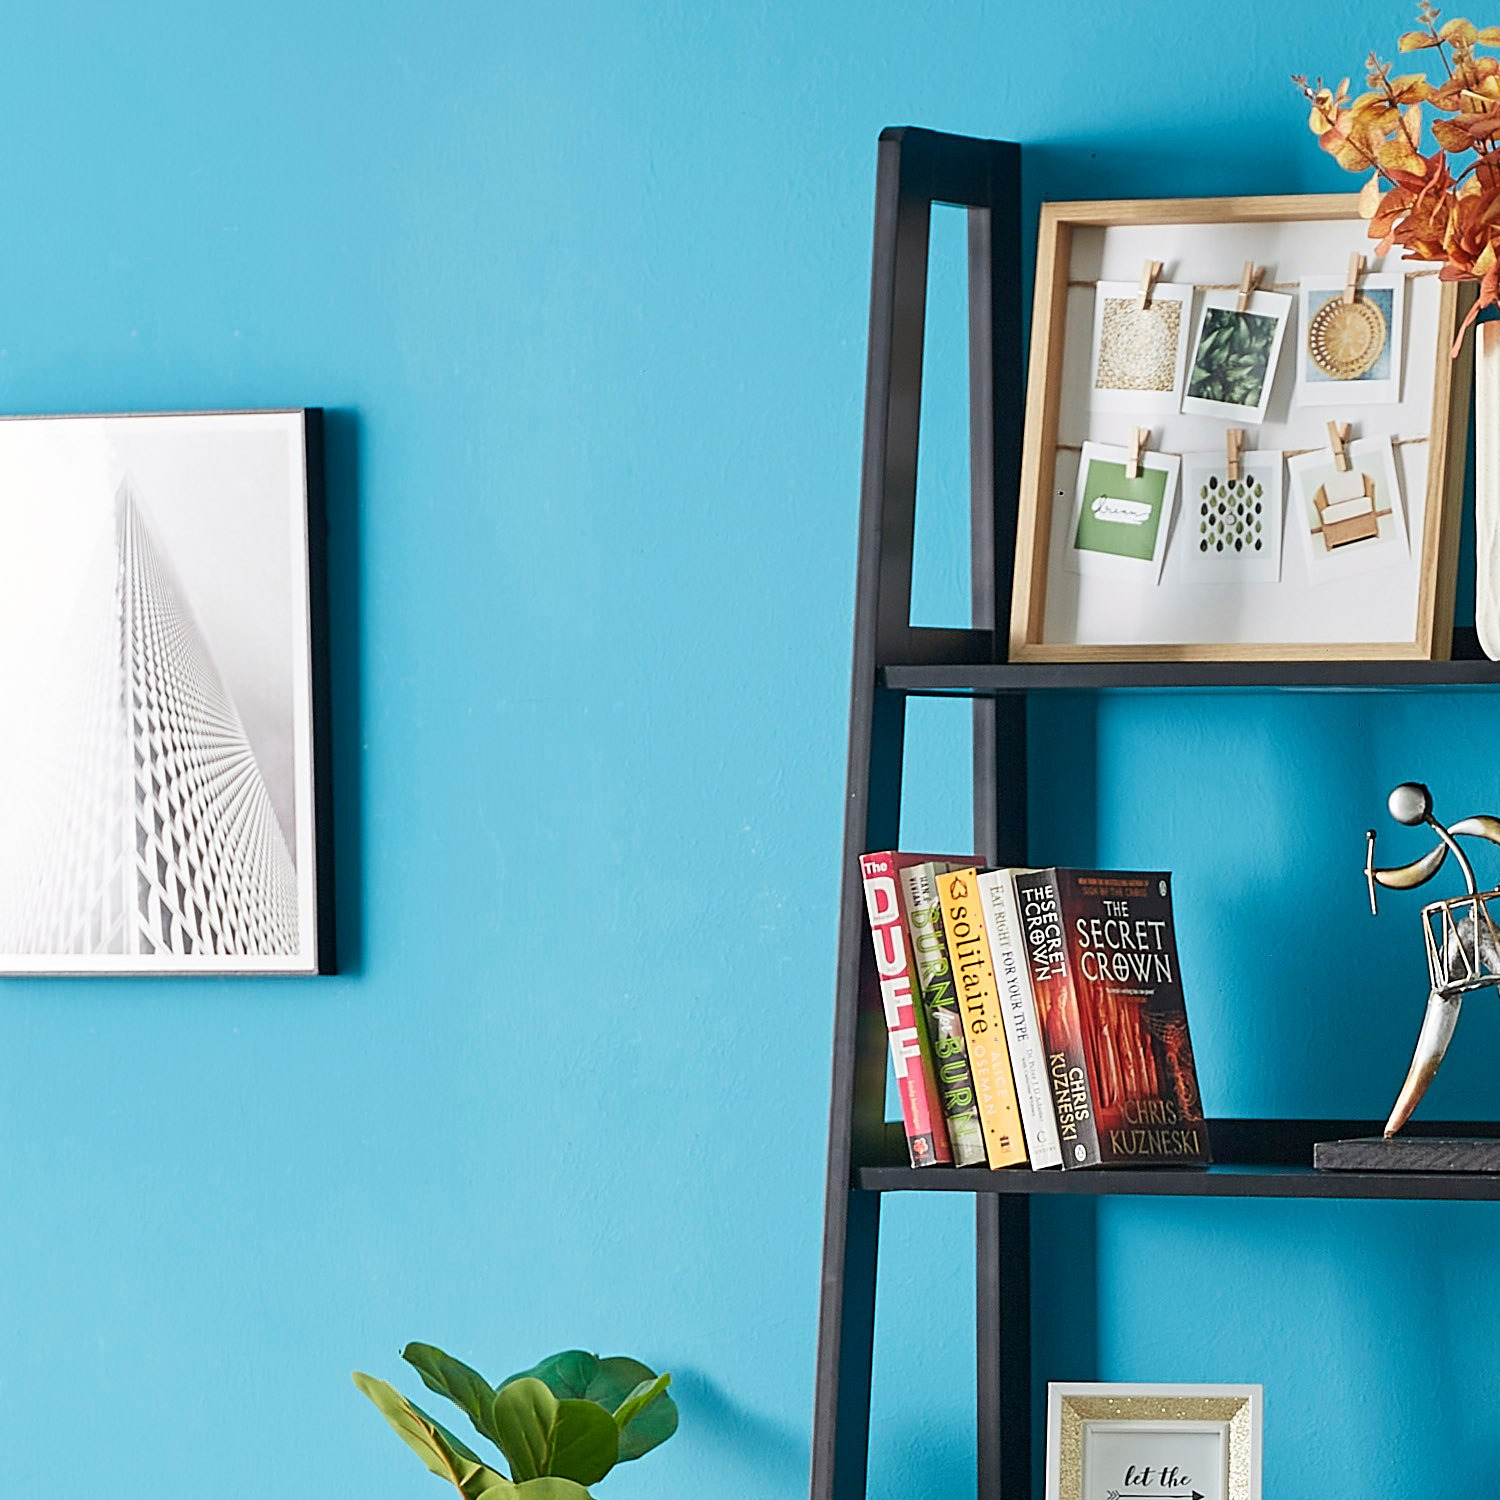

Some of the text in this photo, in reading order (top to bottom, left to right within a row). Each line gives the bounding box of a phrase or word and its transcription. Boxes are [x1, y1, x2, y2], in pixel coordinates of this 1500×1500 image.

[865, 862, 888, 875] The
[990, 885, 1004, 907] EAT
[1103, 900, 1129, 917] THE
[994, 911, 1010, 947] RIGHT
[1025, 902, 1052, 982] CROWN
[1041, 900, 1067, 977] SECRET
[1076, 918, 1166, 950] SECRET
[863, 876, 921, 1079] DUFF
[951, 907, 988, 1034] solitaire
[1002, 951, 1016, 975] FOR
[1081, 951, 1173, 983] CROWN
[1006, 977, 1022, 1010] YOUR
[911, 906, 955, 1009] BURN
[935, 1037, 977, 1137] BURN
[1013, 1012, 1029, 1042] TYPE
[974, 1045, 996, 1115] OSEMAN
[991, 1052, 1007, 1097] ALICE
[1050, 1052, 1078, 1141] KUZNESKI
[1069, 1067, 1090, 1121] CHRIS
[1124, 1100, 1177, 1126] CHRIS
[1109, 1130, 1200, 1155] KUZNESKI
[1124, 1465, 1192, 1487] let the
